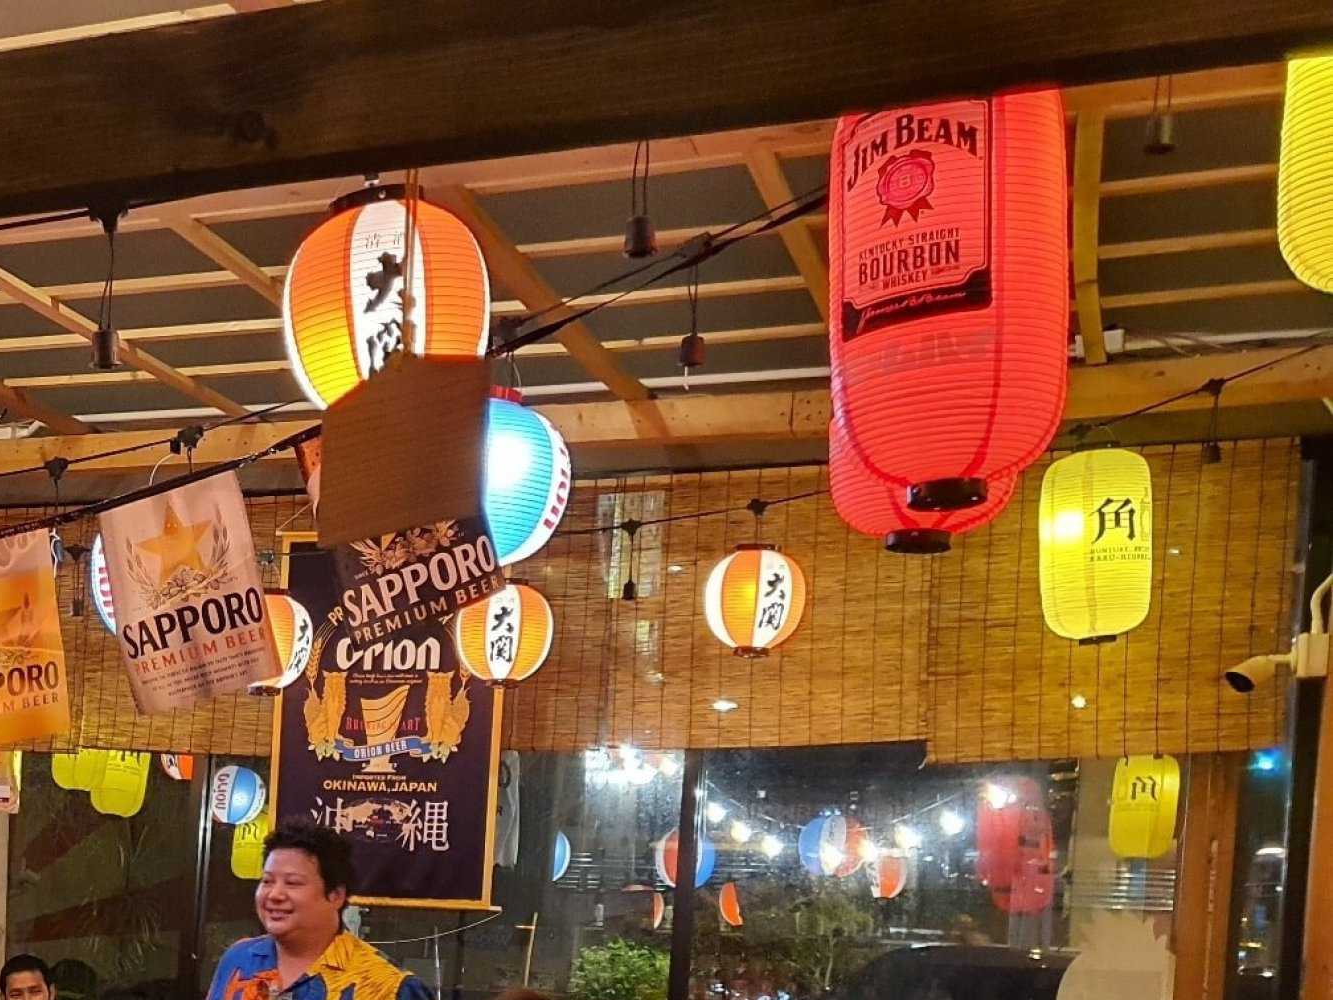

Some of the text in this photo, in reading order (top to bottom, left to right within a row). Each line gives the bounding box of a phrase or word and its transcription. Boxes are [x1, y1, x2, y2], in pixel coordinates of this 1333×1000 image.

[847, 113, 979, 192] JIM BEAM
[859, 228, 961, 261] KENTUCKY STRAIGHT
[859, 240, 960, 286] BOURBON
[882, 269, 928, 290] WHISKEY
[342, 535, 496, 627] SAPPORO
[122, 587, 264, 660] SAPPORO
[355, 597, 449, 645] PREMIUM
[454, 577, 500, 604] BEER
[225, 627, 267, 649] BEER
[21, 692, 62, 710] BEER
